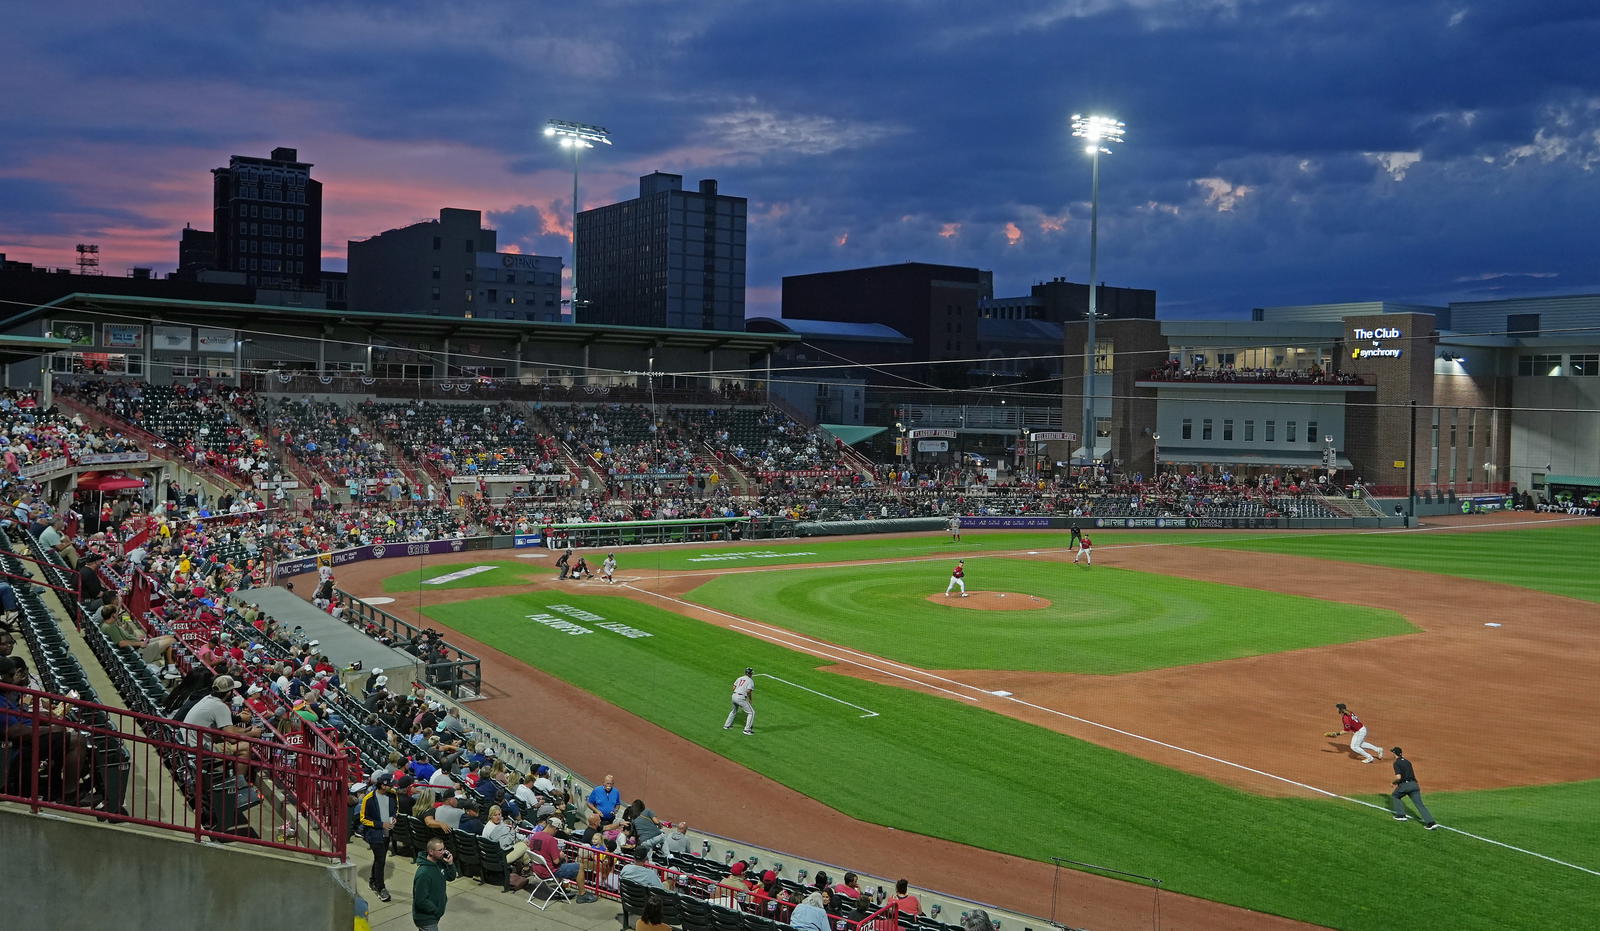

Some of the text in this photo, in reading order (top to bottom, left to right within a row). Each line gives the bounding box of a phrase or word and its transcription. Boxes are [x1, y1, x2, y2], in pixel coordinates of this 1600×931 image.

[1354, 328, 1400, 340] The Club
[1360, 348, 1400, 358] synchrony
[332, 554, 348, 564] UPMC
[277, 566, 292, 576] PMC
[738, 679, 746, 687] 17
[287, 736, 304, 744] 105
